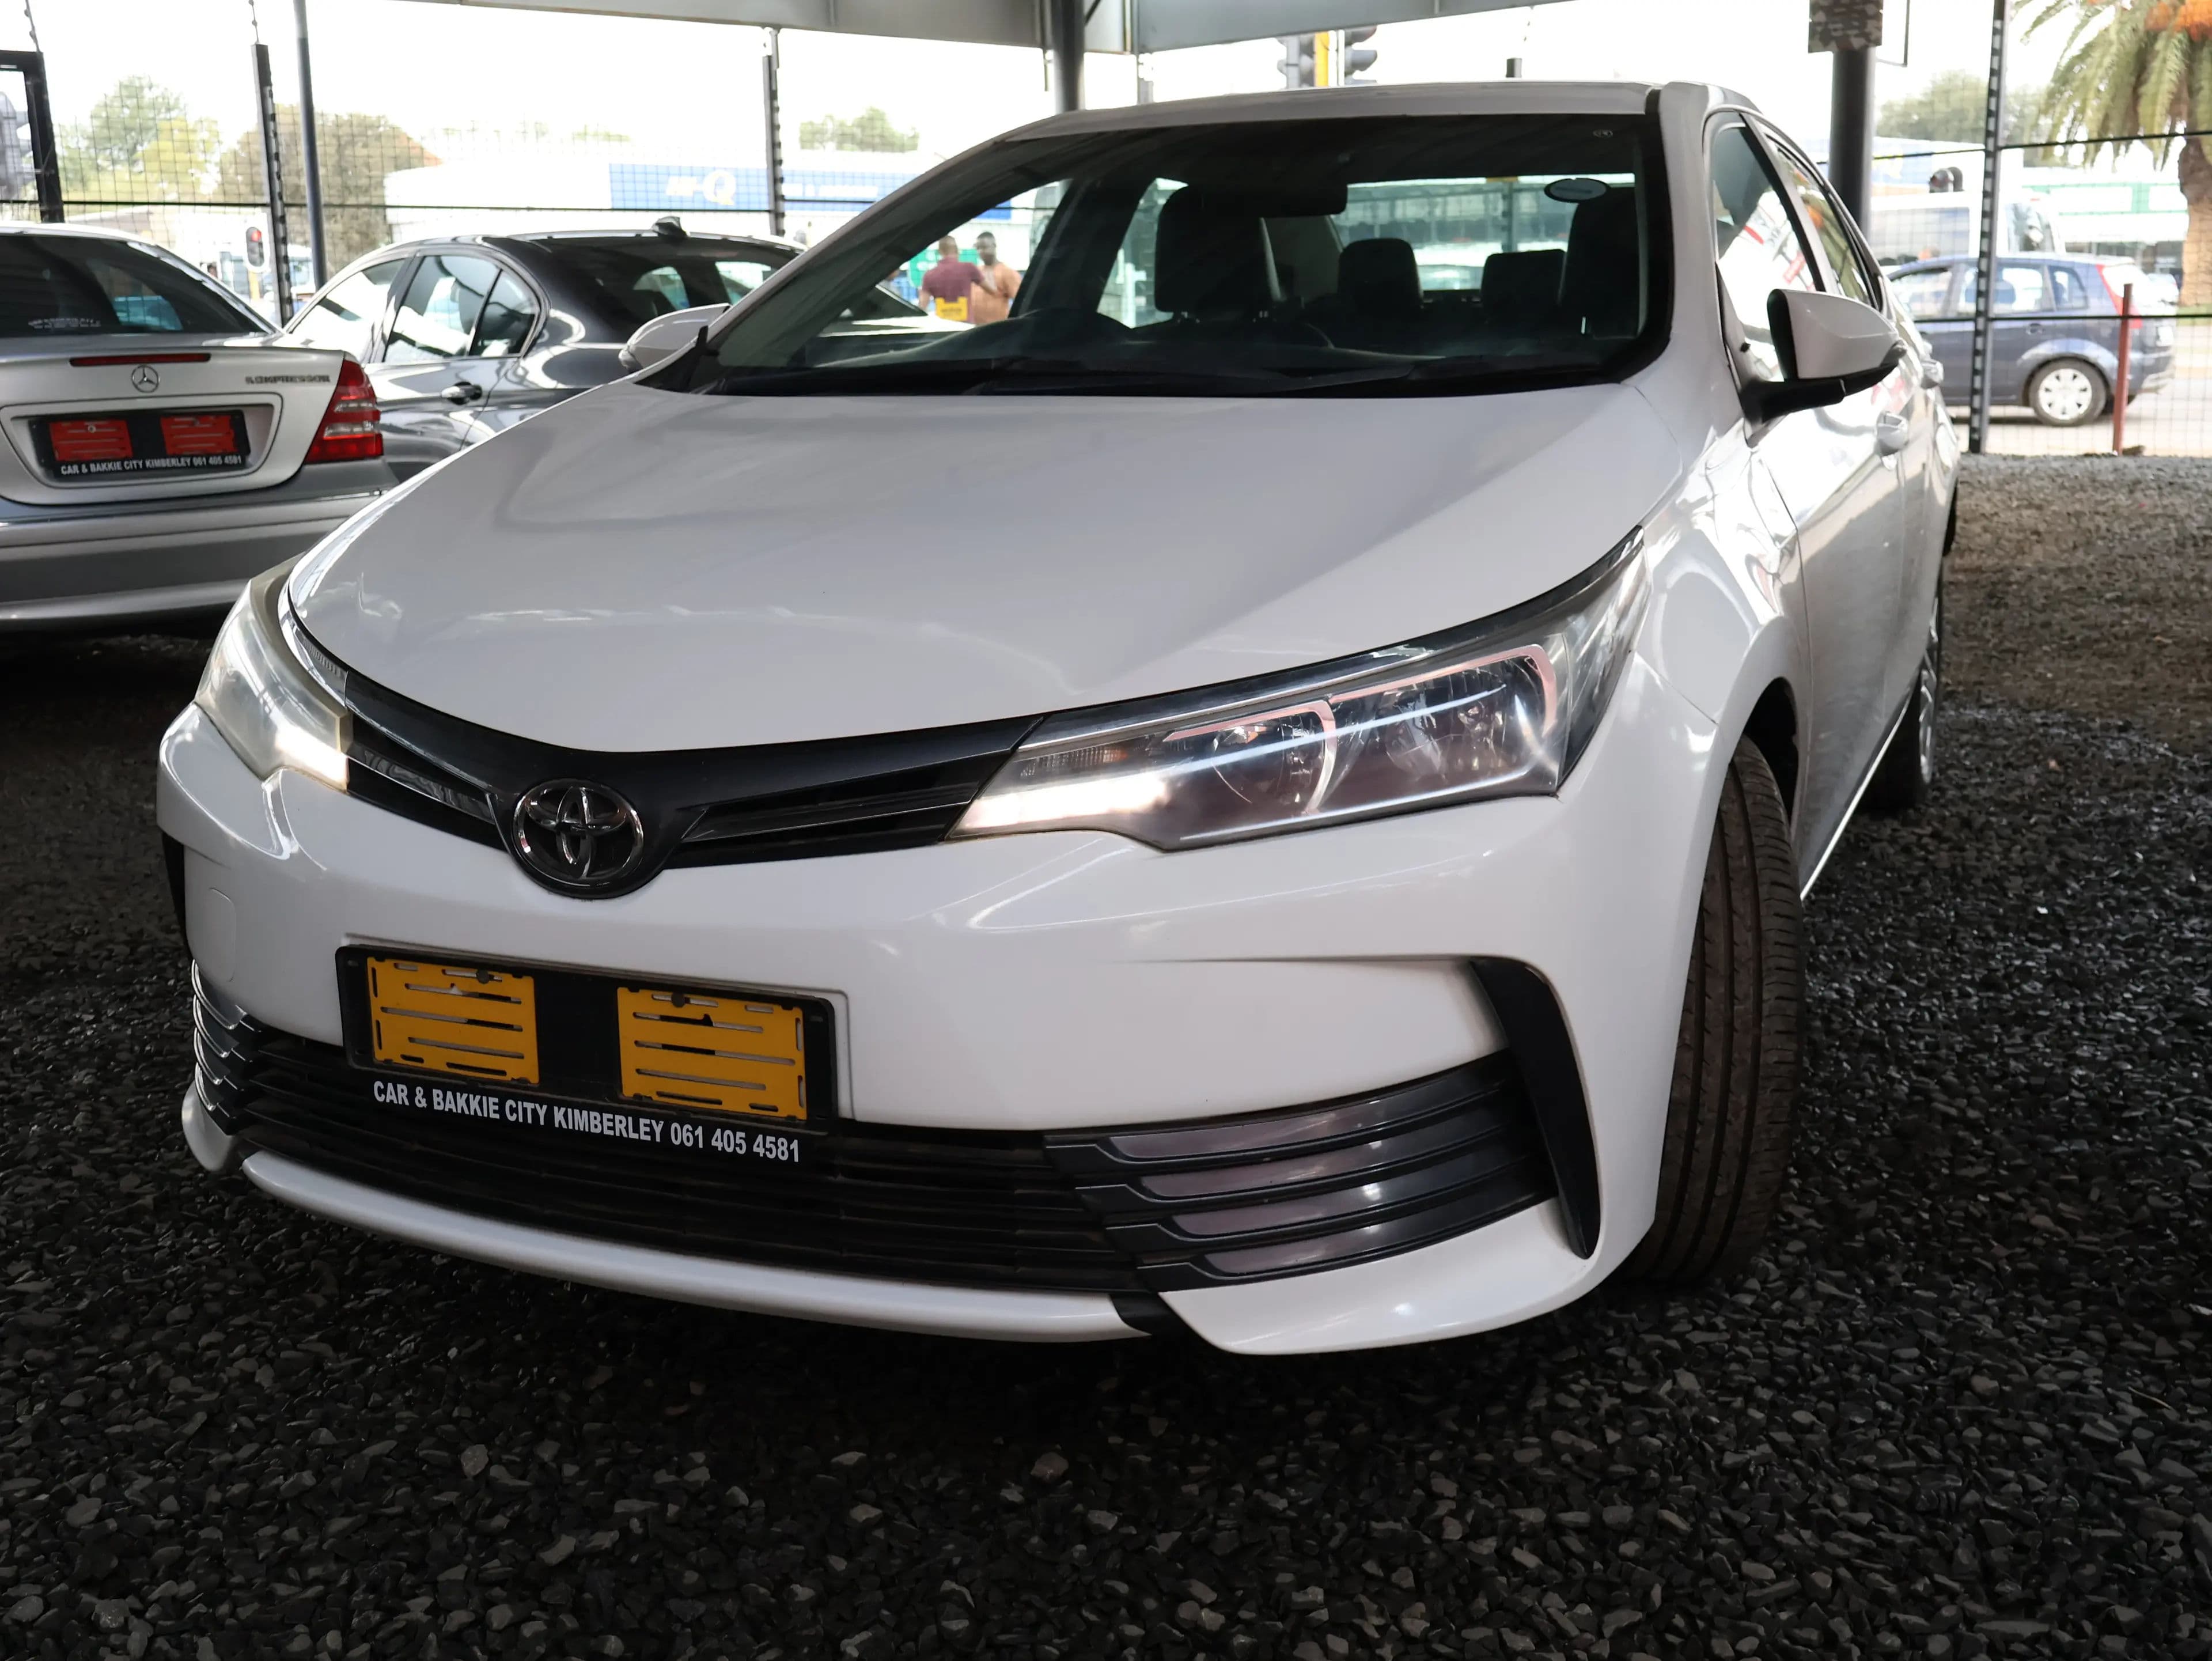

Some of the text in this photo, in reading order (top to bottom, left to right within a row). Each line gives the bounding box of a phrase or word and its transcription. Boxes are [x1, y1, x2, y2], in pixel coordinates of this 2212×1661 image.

[60, 464, 79, 475] CAR
[81, 463, 88, 474] &
[89, 461, 123, 473] BAKKIE
[124, 459, 143, 470] CITY
[145, 457, 191, 468] KIMBERLEY
[374, 1081, 800, 1163] CAR & BAKKIE CITY KIMBERLEY 061 405 4581
